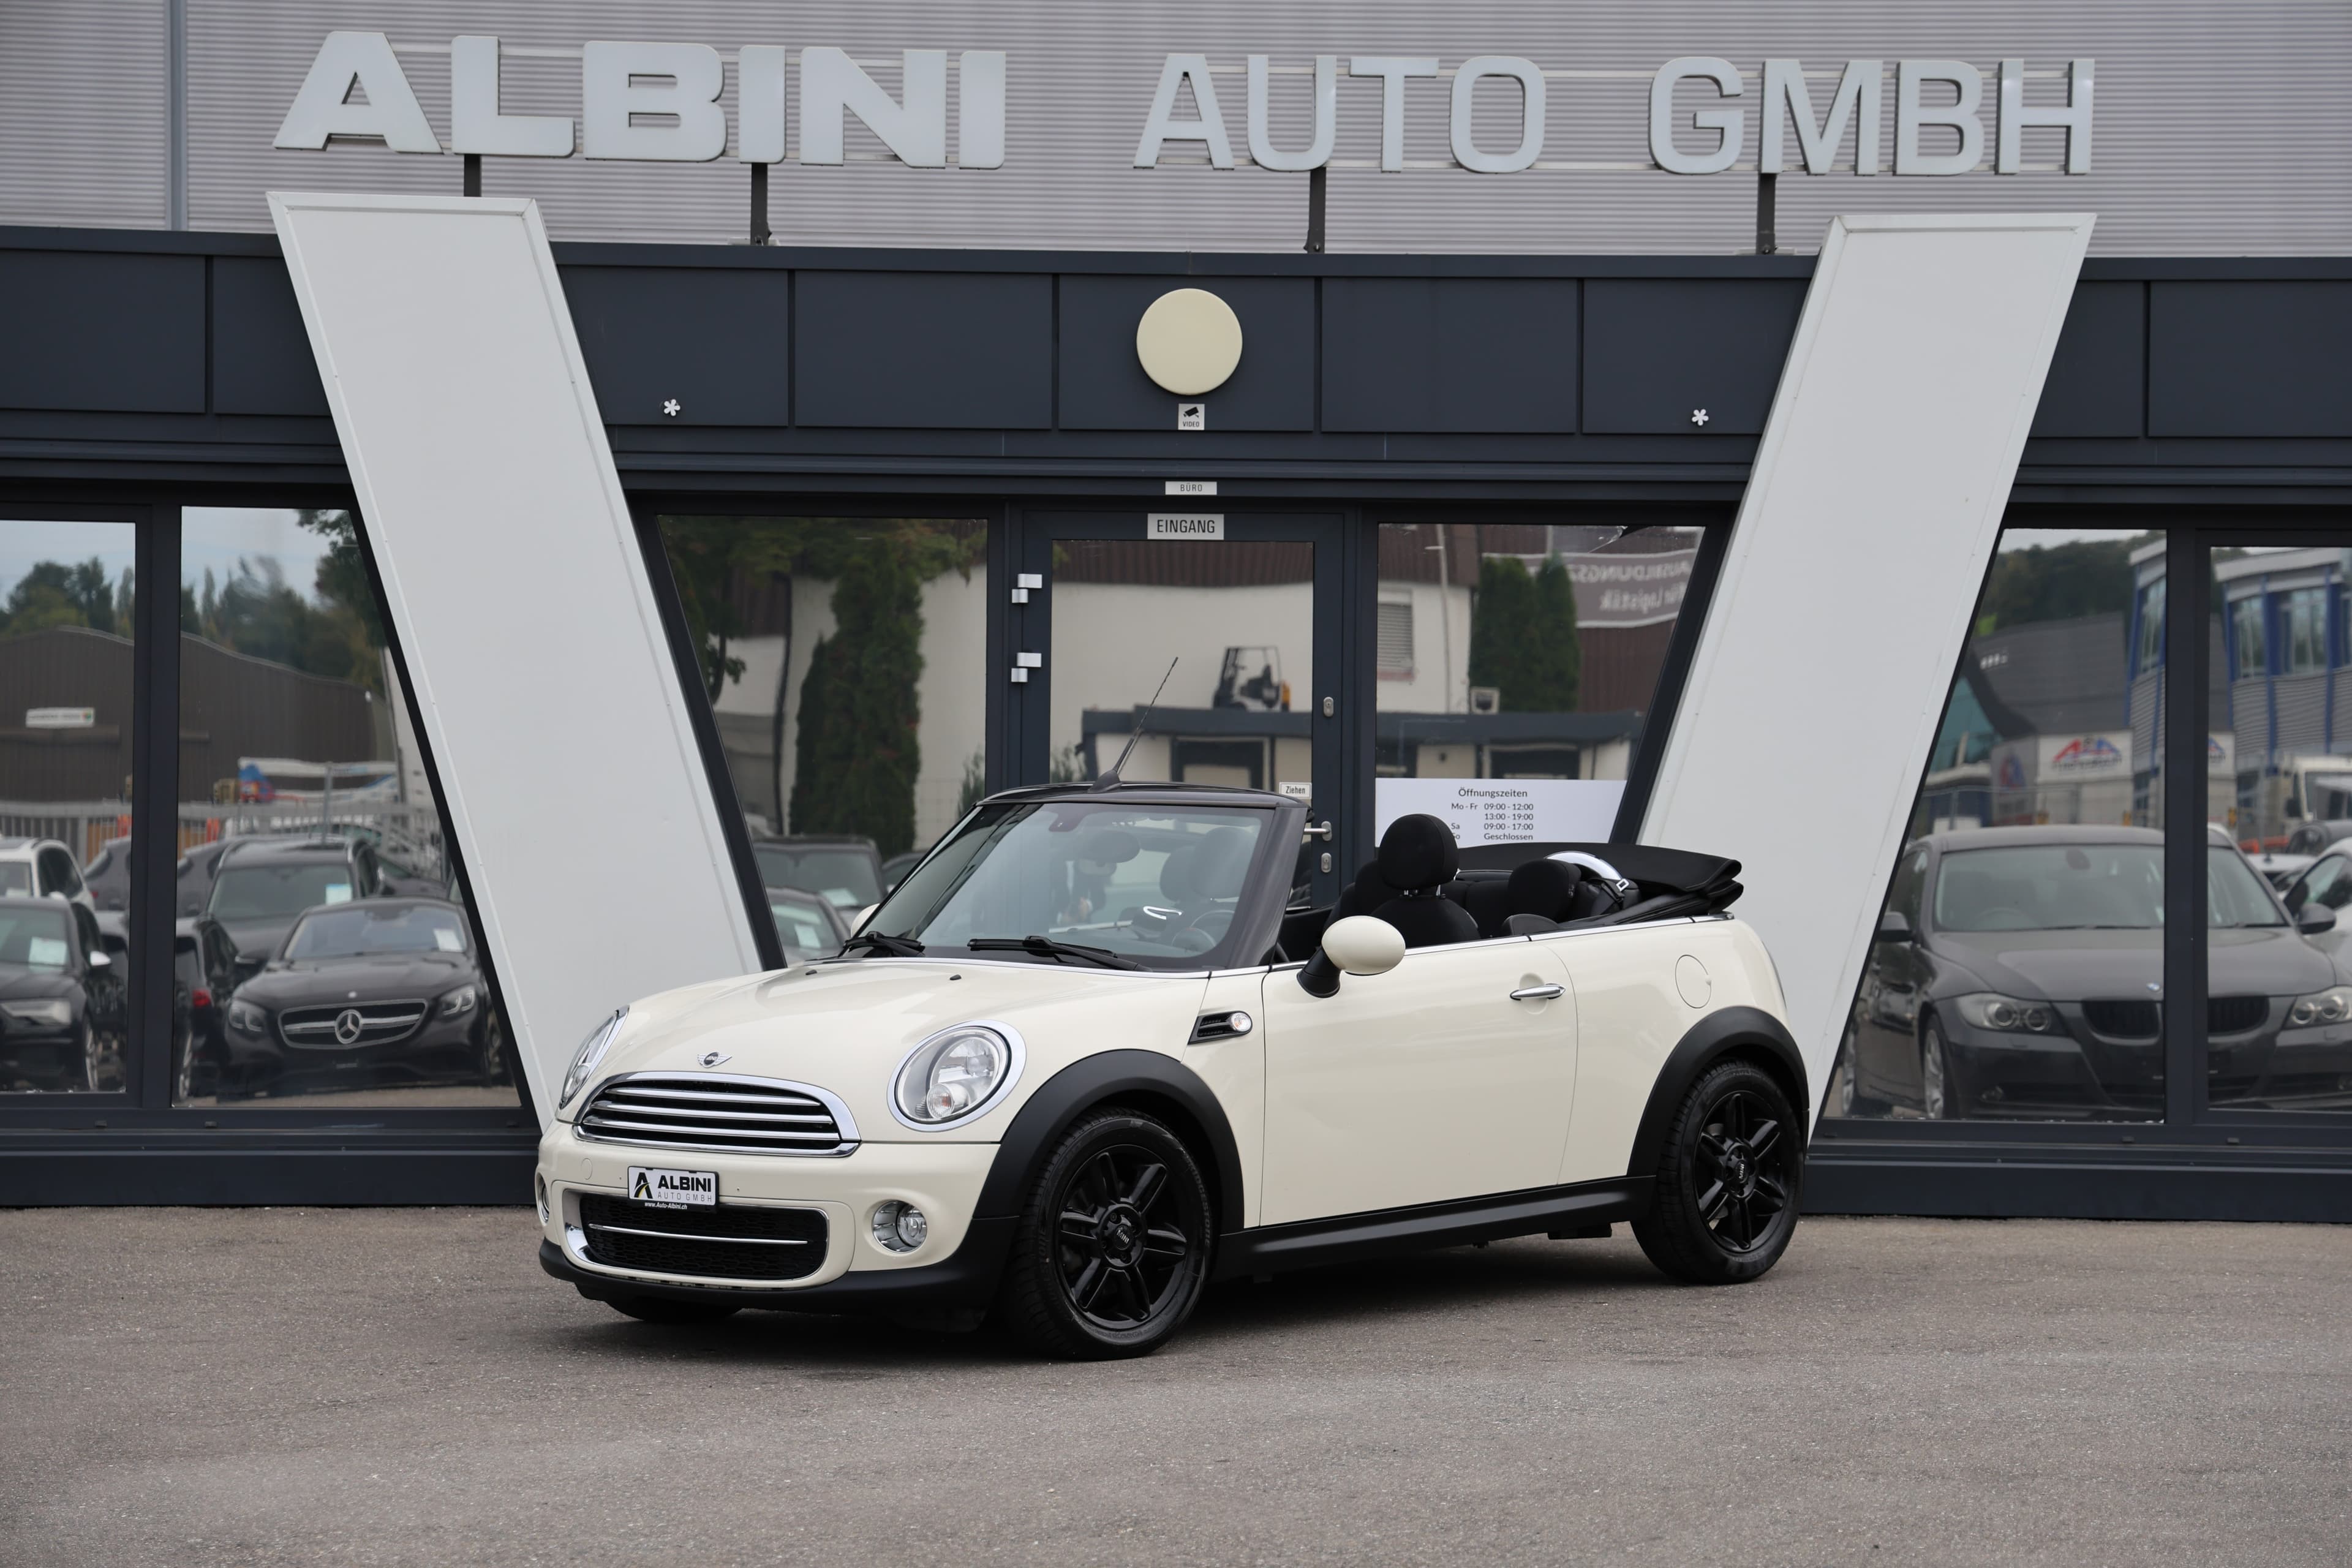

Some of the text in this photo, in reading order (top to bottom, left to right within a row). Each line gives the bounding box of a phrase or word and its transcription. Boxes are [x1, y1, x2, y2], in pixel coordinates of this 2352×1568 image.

[272, 30, 2095, 177] ALBINI AUTO GMBH
[1180, 482, 1203, 492] BÜRO
[1157, 519, 1215, 533] EINGANG
[1286, 786, 1306, 794] Ziehen
[1458, 787, 1528, 799] Öffnungszeiten
[657, 1175, 712, 1193] ALBINI
[658, 1191, 712, 1202] AUTO GMBH
[1117, 1229, 1129, 1244] MINI
